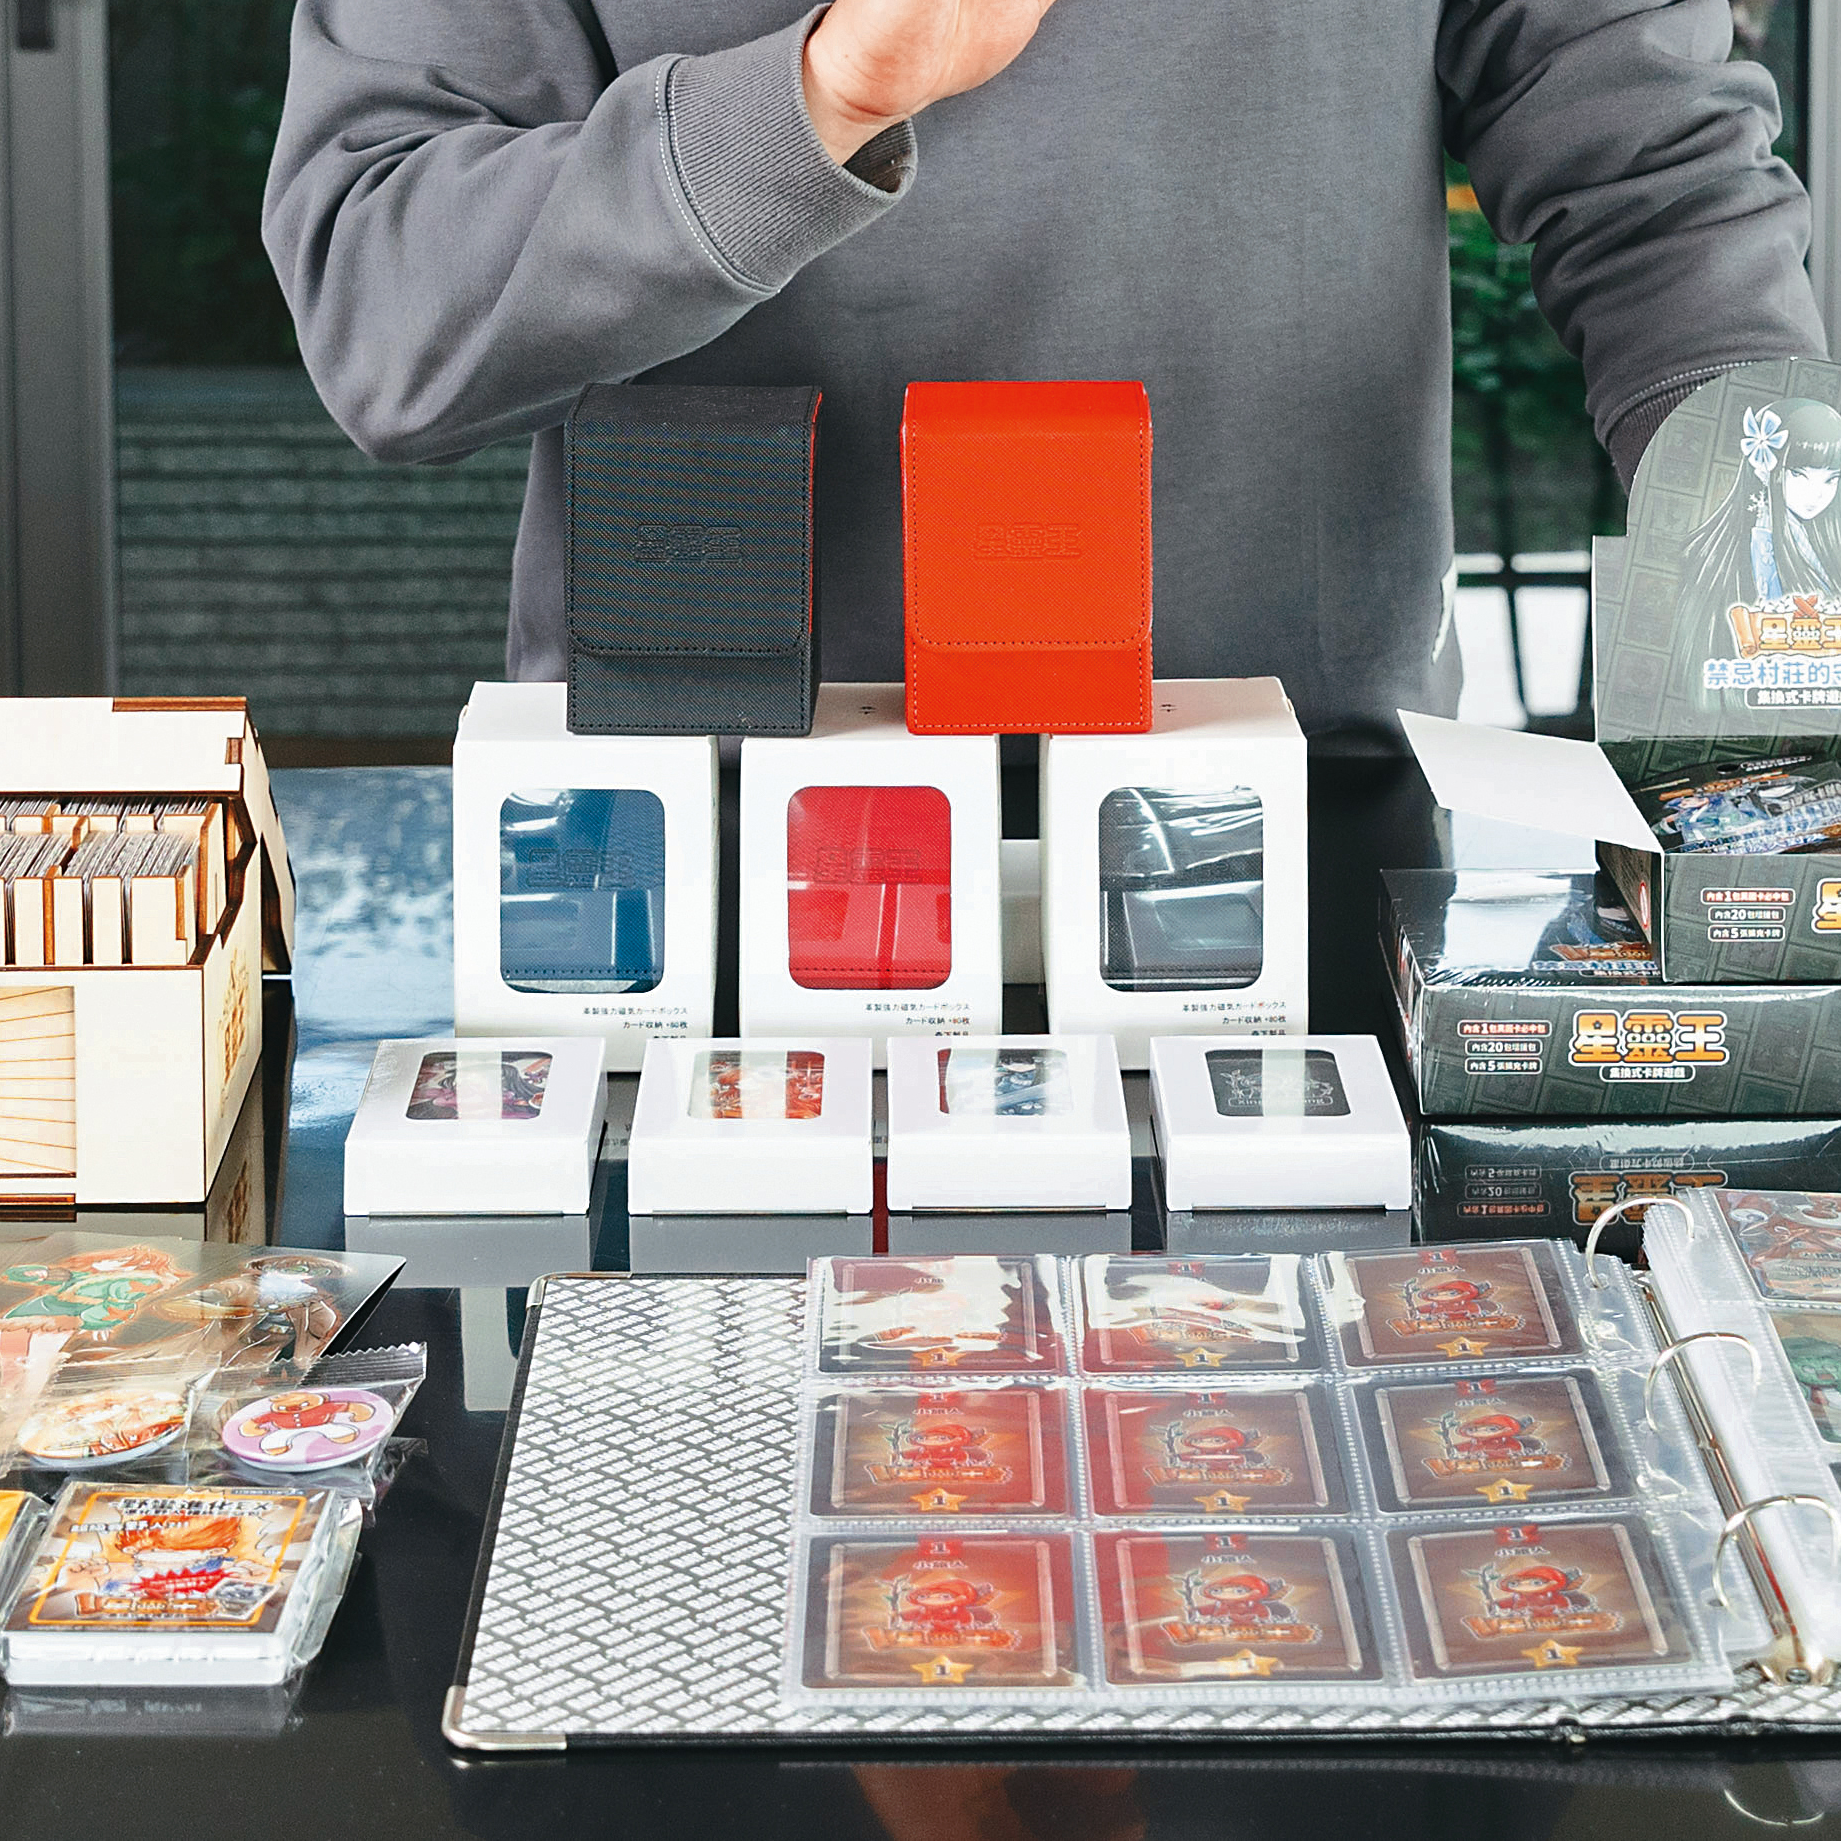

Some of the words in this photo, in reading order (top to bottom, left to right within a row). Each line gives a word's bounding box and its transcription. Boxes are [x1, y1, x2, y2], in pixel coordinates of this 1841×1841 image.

[1571, 1013, 1725, 1064] 星靈王
[1609, 1066, 1686, 1079] 集換式卡牌遊戲
